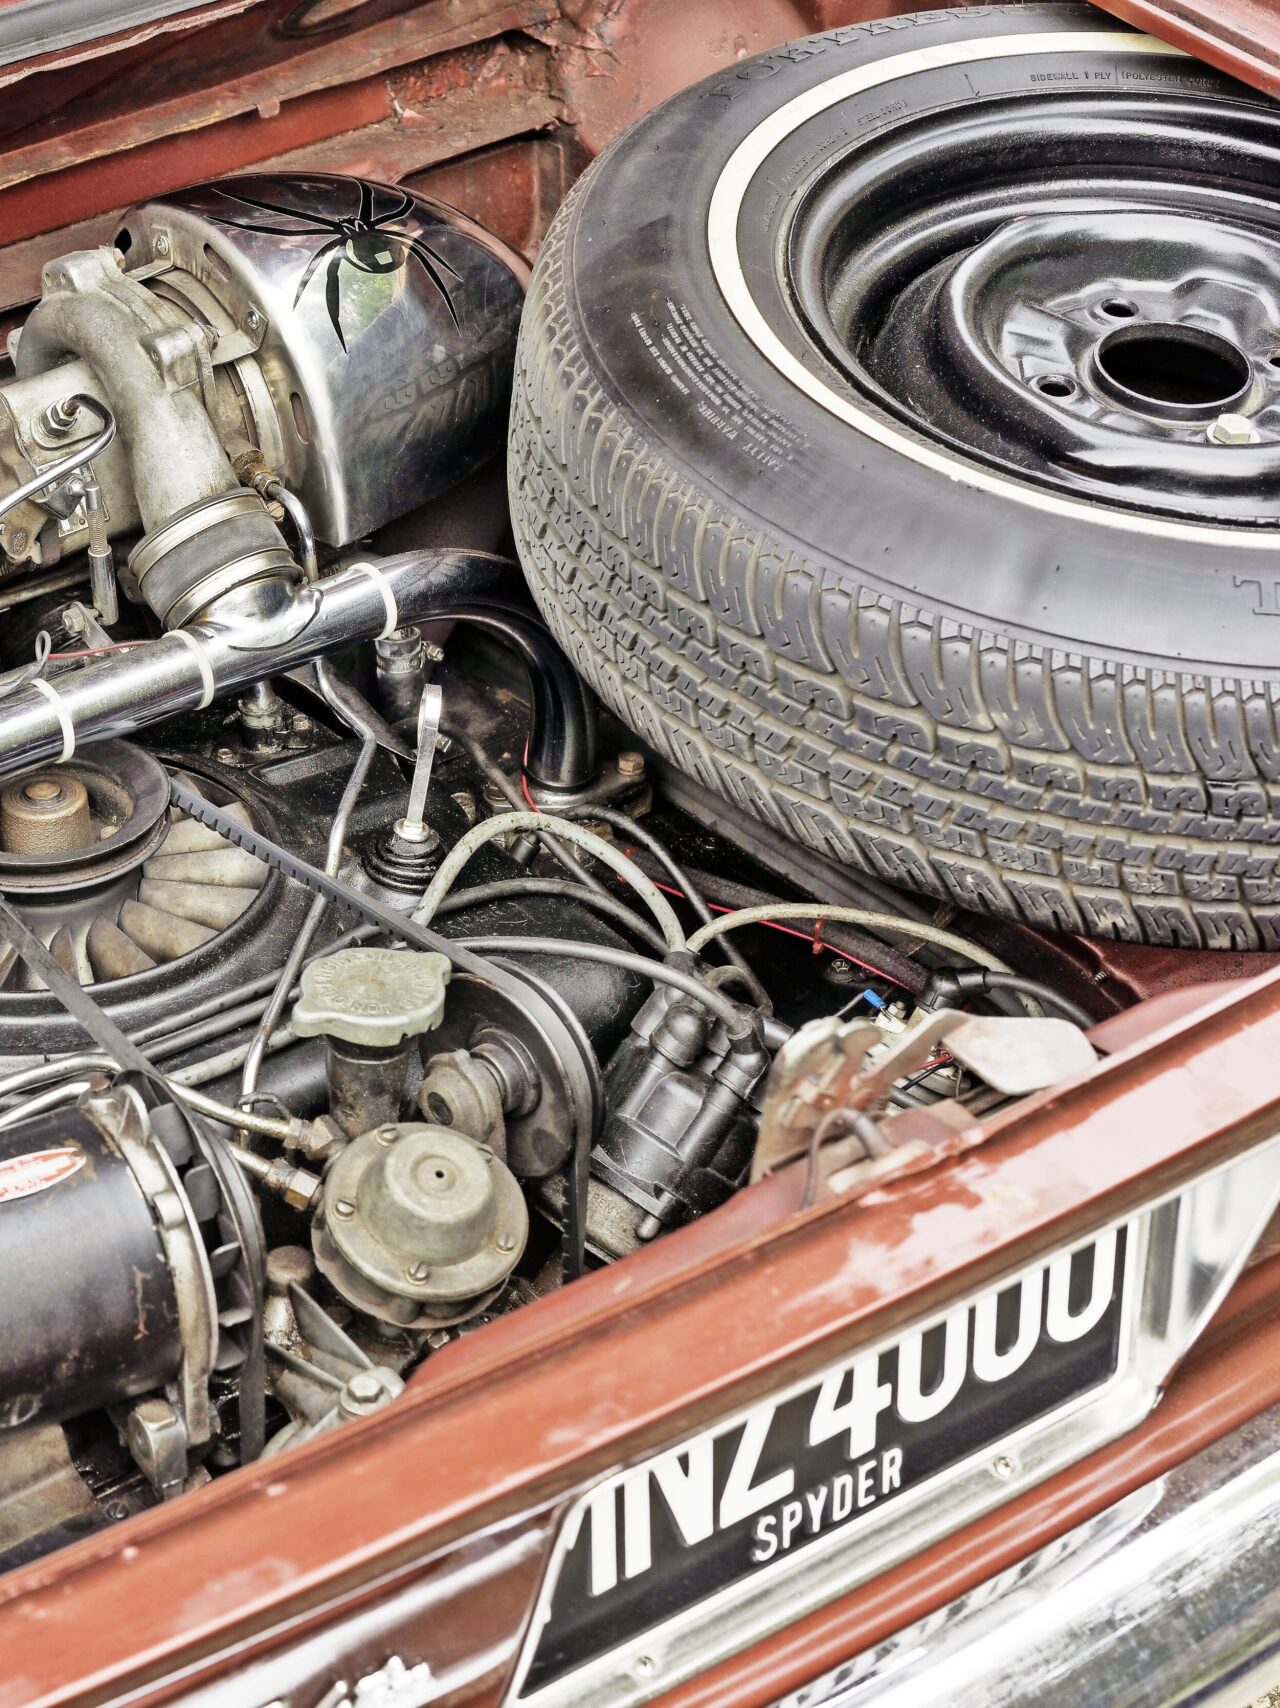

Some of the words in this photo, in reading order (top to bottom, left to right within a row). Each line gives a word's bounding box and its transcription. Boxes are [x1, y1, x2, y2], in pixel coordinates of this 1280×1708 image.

[1030, 72, 1079, 82] SIDEWALL
[1094, 72, 1112, 80] PLY
[808, 1224, 1118, 1459] 4000
[753, 1447, 904, 1563] SPYDER
